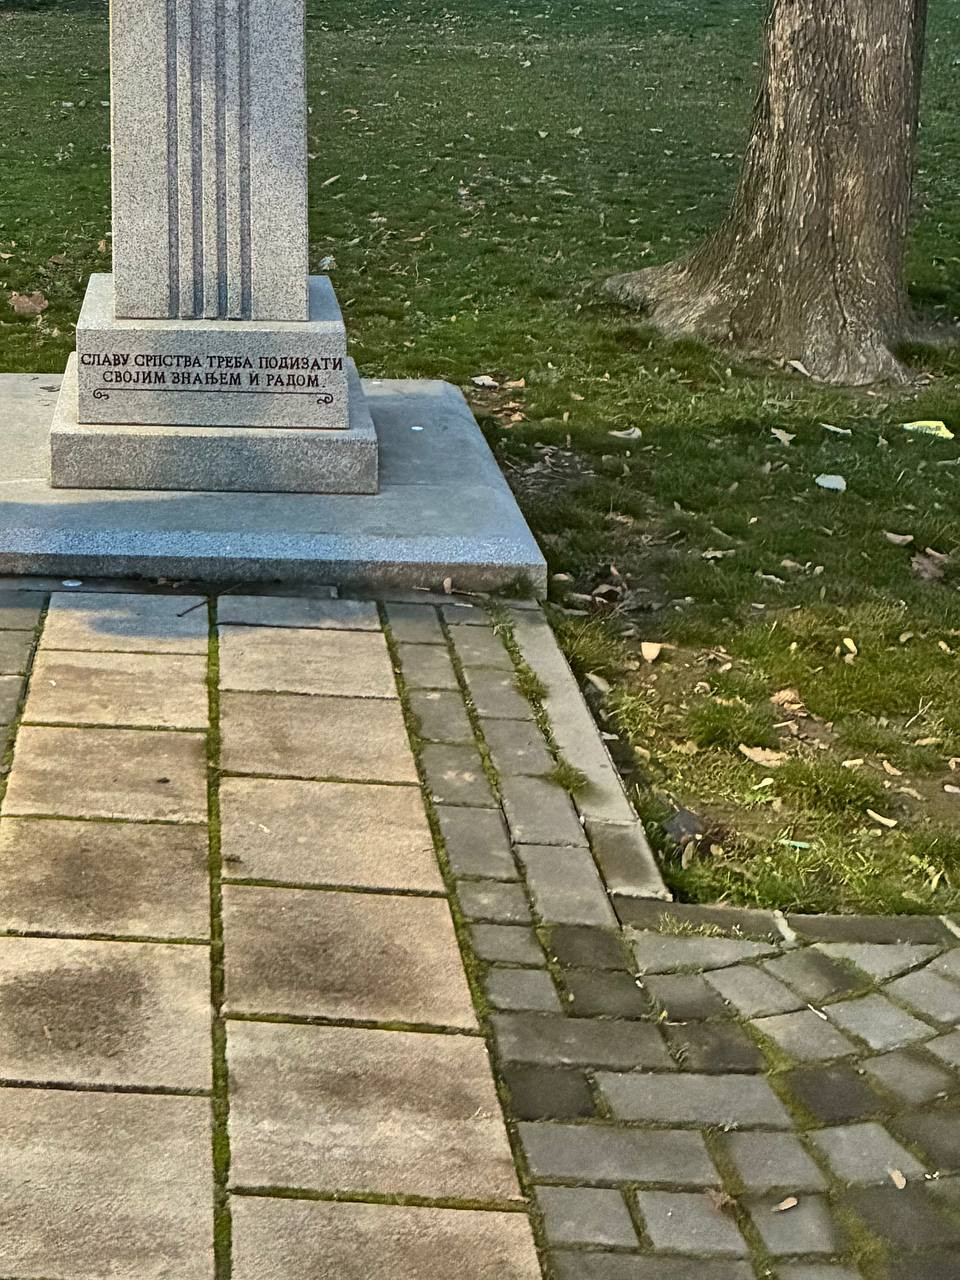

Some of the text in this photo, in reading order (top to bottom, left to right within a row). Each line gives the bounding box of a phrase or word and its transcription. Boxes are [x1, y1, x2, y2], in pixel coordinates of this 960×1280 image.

[80, 353, 344, 371] СЛАВУ СРПСТВА ТРЕБА ПОДИЗАТИ
[102, 370, 166, 384] СВОЈИМ
[171, 371, 242, 386] ЗНАЊЕМ
[249, 373, 260, 386] И
